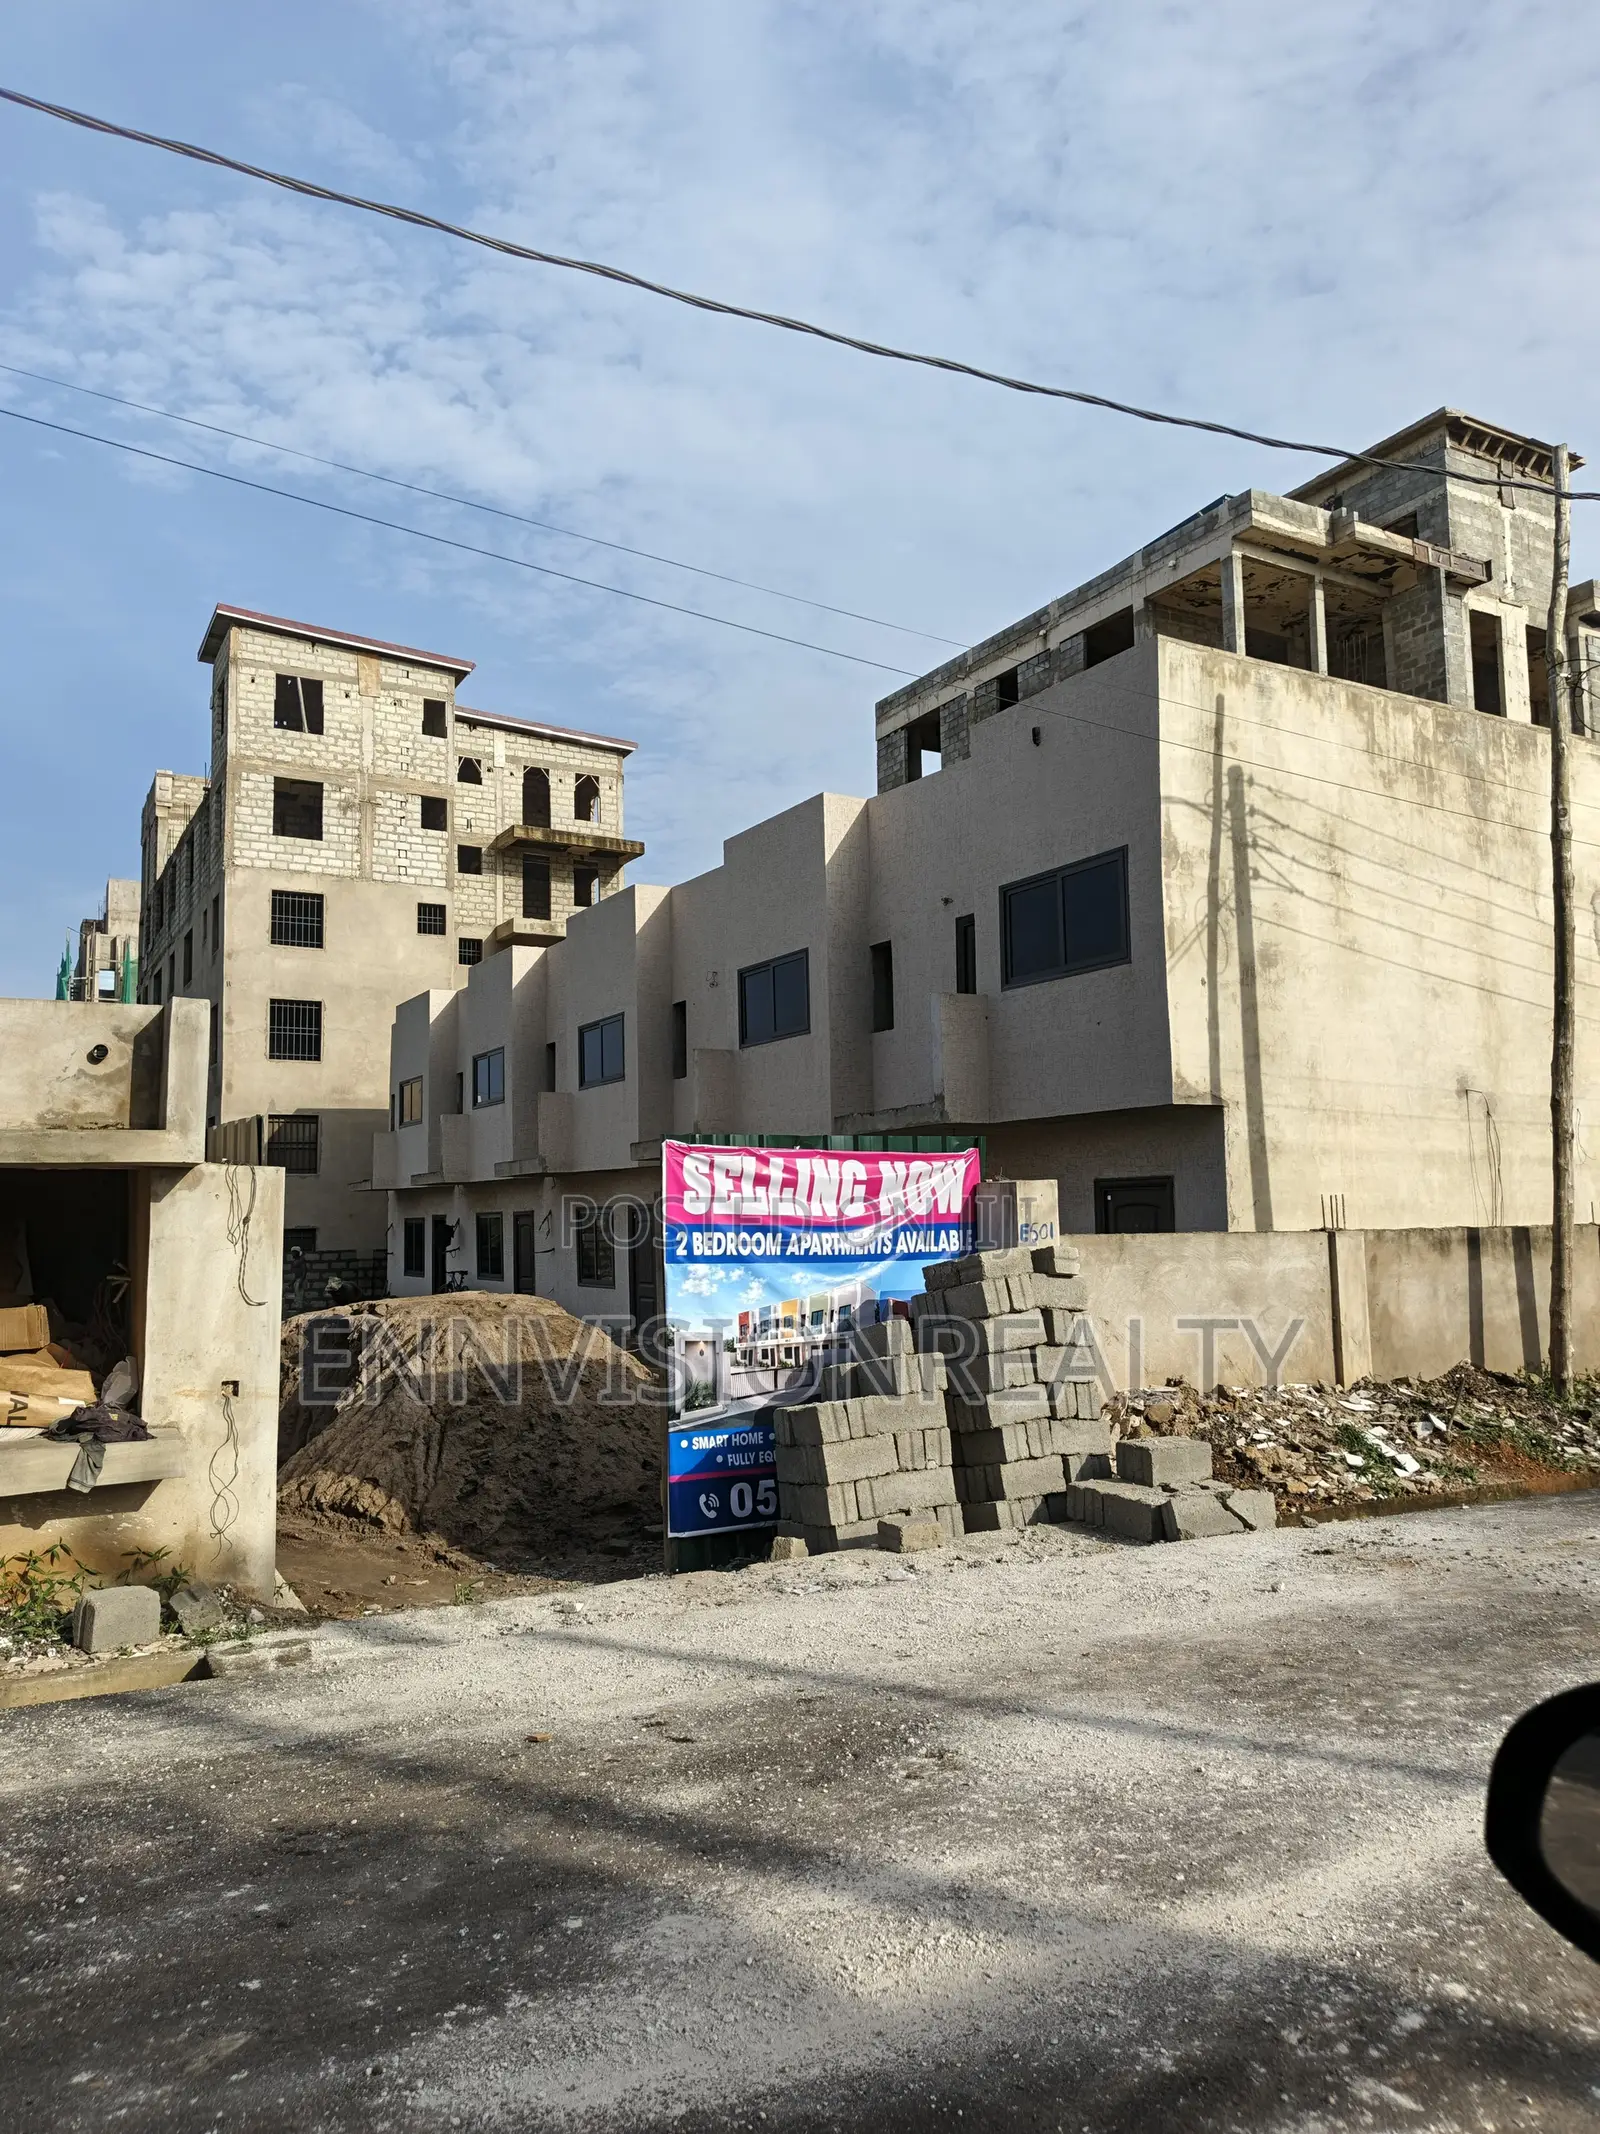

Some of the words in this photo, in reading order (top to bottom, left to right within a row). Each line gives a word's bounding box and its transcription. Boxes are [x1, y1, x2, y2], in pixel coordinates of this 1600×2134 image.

[683, 1153, 867, 1216] SELLING
[878, 1158, 965, 1216] NOW
[676, 1231, 688, 1256] 2
[692, 1231, 782, 1256] BEDROOM
[785, 1231, 893, 1256] APARTMENTS
[896, 1229, 972, 1254] AVAILABLE
[1020, 1222, 1054, 1243] E501
[691, 1434, 729, 1450] SMART
[731, 1432, 764, 1447] HOME
[727, 1451, 756, 1466] FULLY
[730, 1479, 776, 1518] 05
